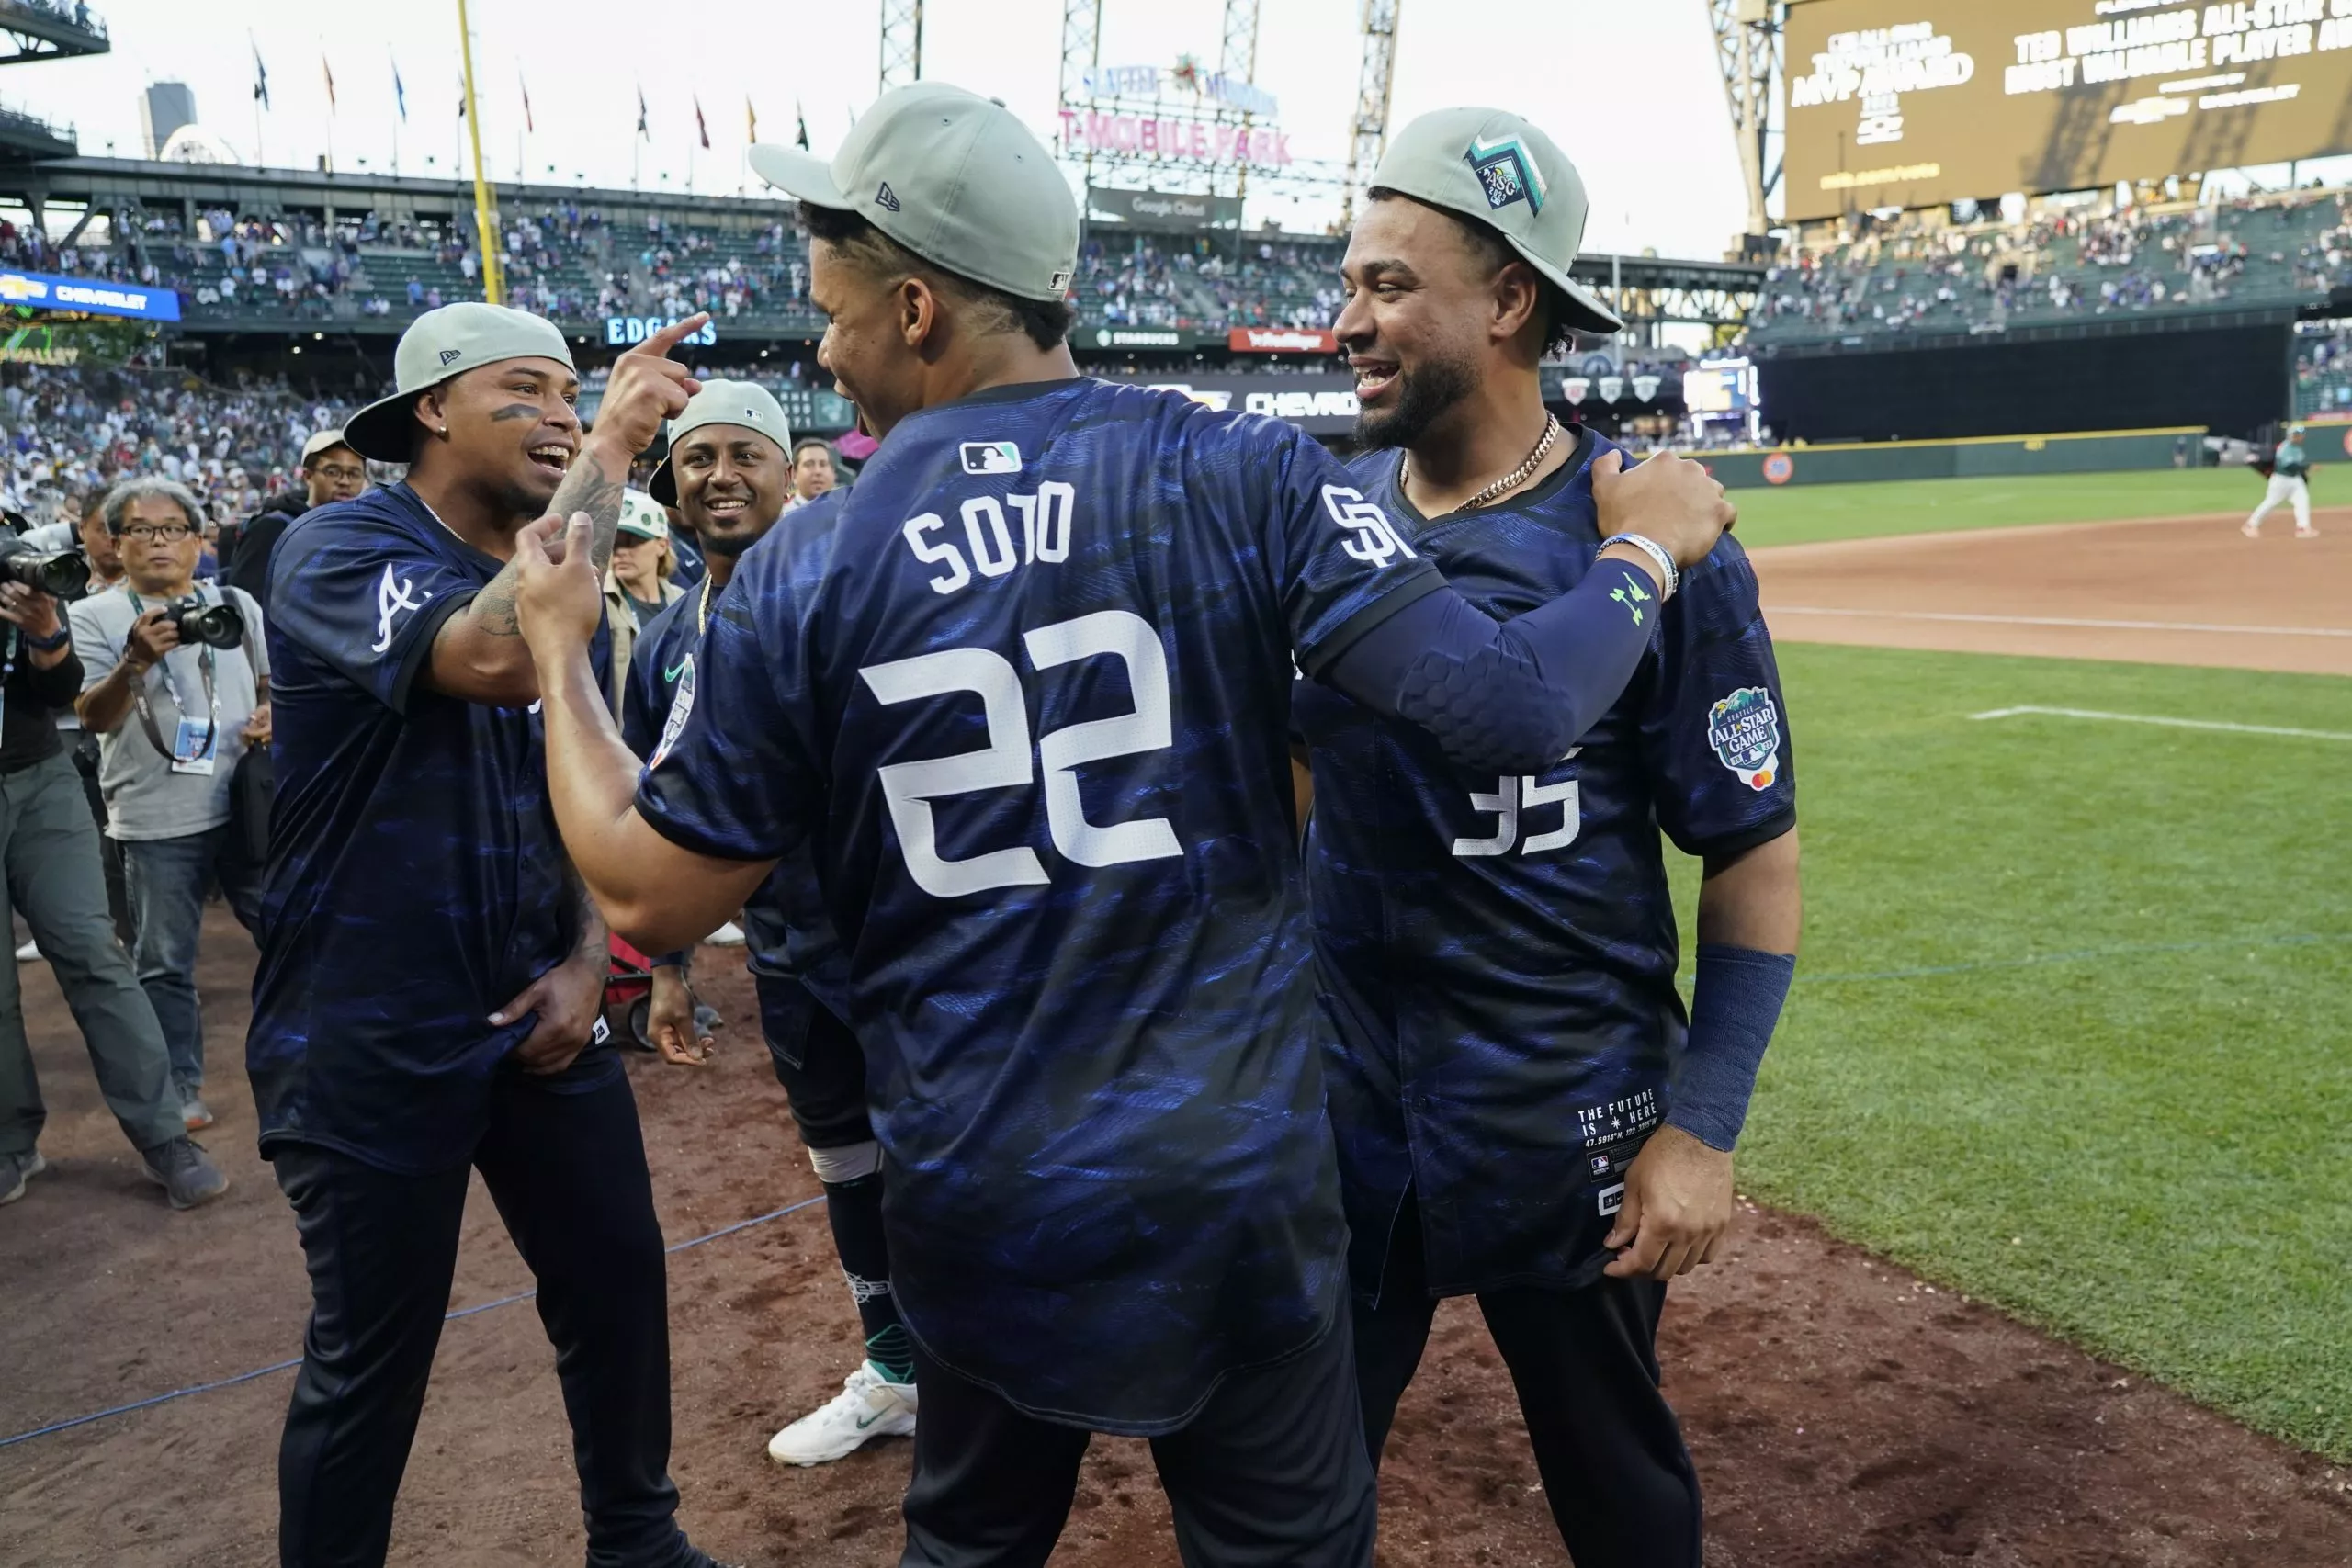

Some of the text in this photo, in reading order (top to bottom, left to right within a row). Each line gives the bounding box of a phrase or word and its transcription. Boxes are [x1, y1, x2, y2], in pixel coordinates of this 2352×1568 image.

[1059, 111, 1292, 166] T-MOBILE PARK
[1486, 172, 1516, 196] ASG
[1113, 330, 1180, 345] STARBUCKS
[902, 480, 1075, 595] SOTO
[1727, 705, 1754, 723] SEATTLE
[857, 609, 1184, 898] 22
[1728, 726, 1768, 753] GAME
[1578, 1088, 1654, 1122] THE FUTURE
[1582, 1102, 1657, 1137] IS HERE
